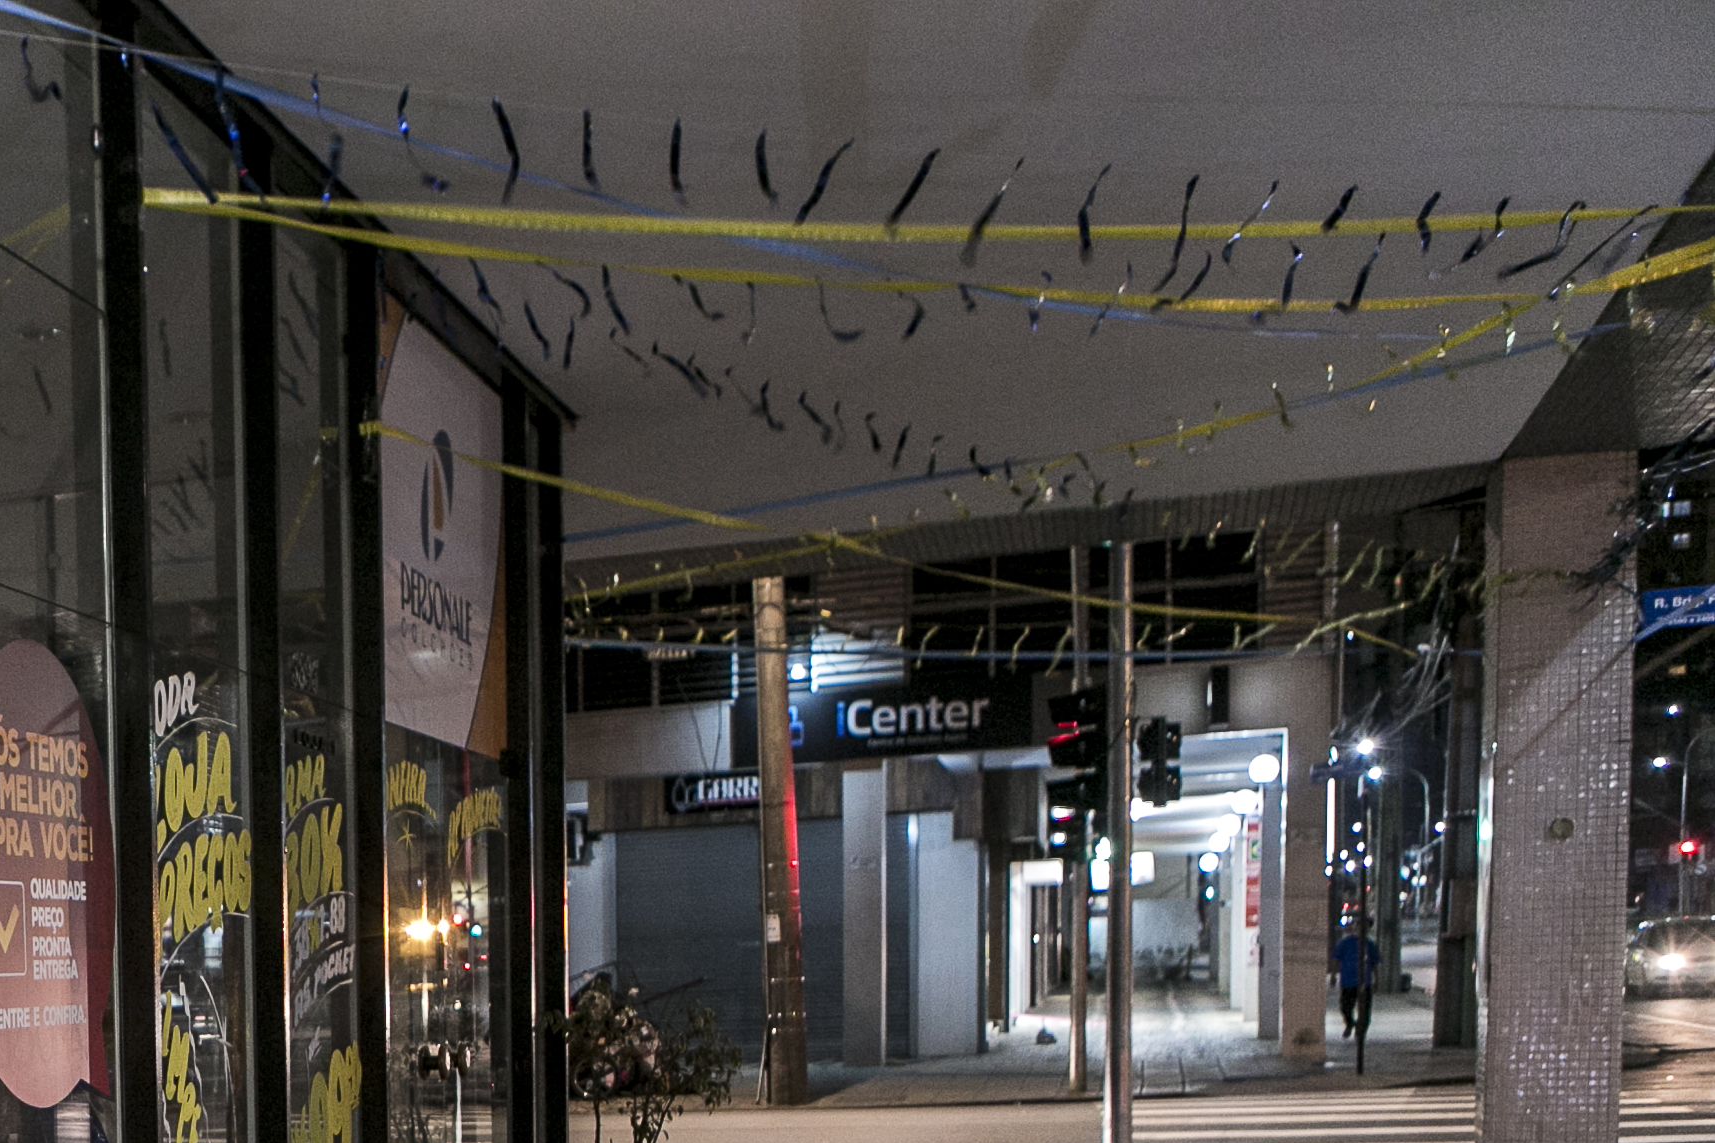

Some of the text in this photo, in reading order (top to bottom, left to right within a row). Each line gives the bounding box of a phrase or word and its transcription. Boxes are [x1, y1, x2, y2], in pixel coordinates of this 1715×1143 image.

[400, 561, 473, 647] PERSONALE
[835, 696, 990, 738] iCenter
[26, 731, 89, 779] TEMOS
[0, 771, 78, 819] MELHOR
[39, 813, 94, 862] VOCÊ!
[30, 877, 87, 901] QUALIDADE
[31, 905, 65, 934] PREÇO
[32, 936, 73, 957] PRONTA
[33, 959, 79, 981] ENTREGA
[33, 1006, 40, 1027] E
